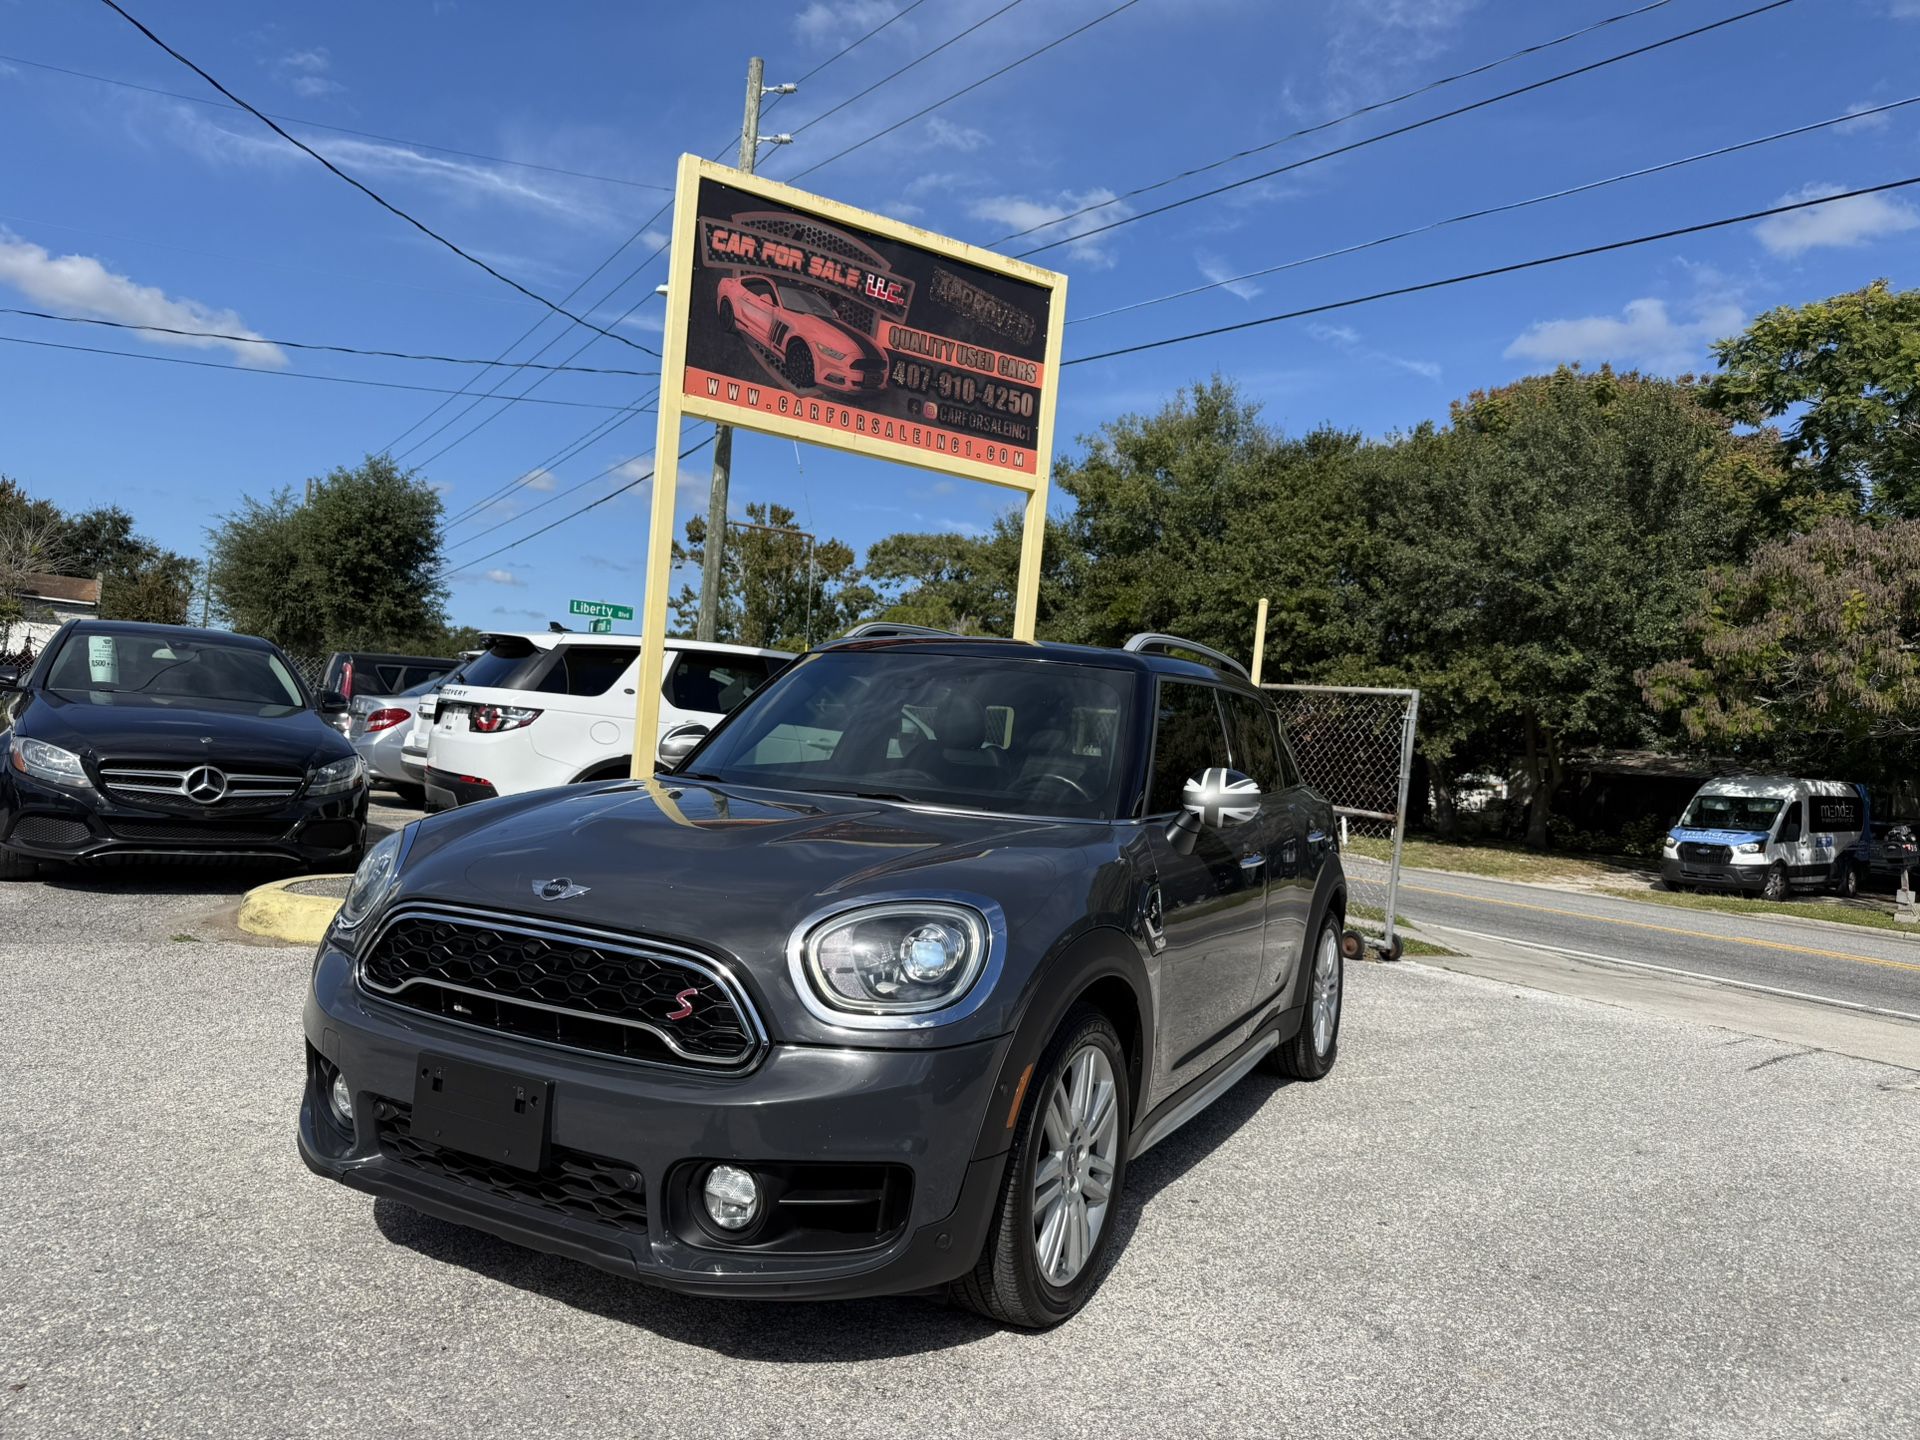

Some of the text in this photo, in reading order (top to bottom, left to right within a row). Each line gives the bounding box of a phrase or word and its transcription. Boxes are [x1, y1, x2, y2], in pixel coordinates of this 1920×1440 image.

[711, 229, 756, 258] CAR
[760, 242, 804, 274] FOR
[889, 325, 1037, 383] QUALITY USED CARS
[892, 360, 1034, 418] 407-910-4250
[940, 406, 1031, 441] CARFORSALEINC1
[573, 601, 630, 619] Liberty Blvd
[665, 987, 699, 1021] S
